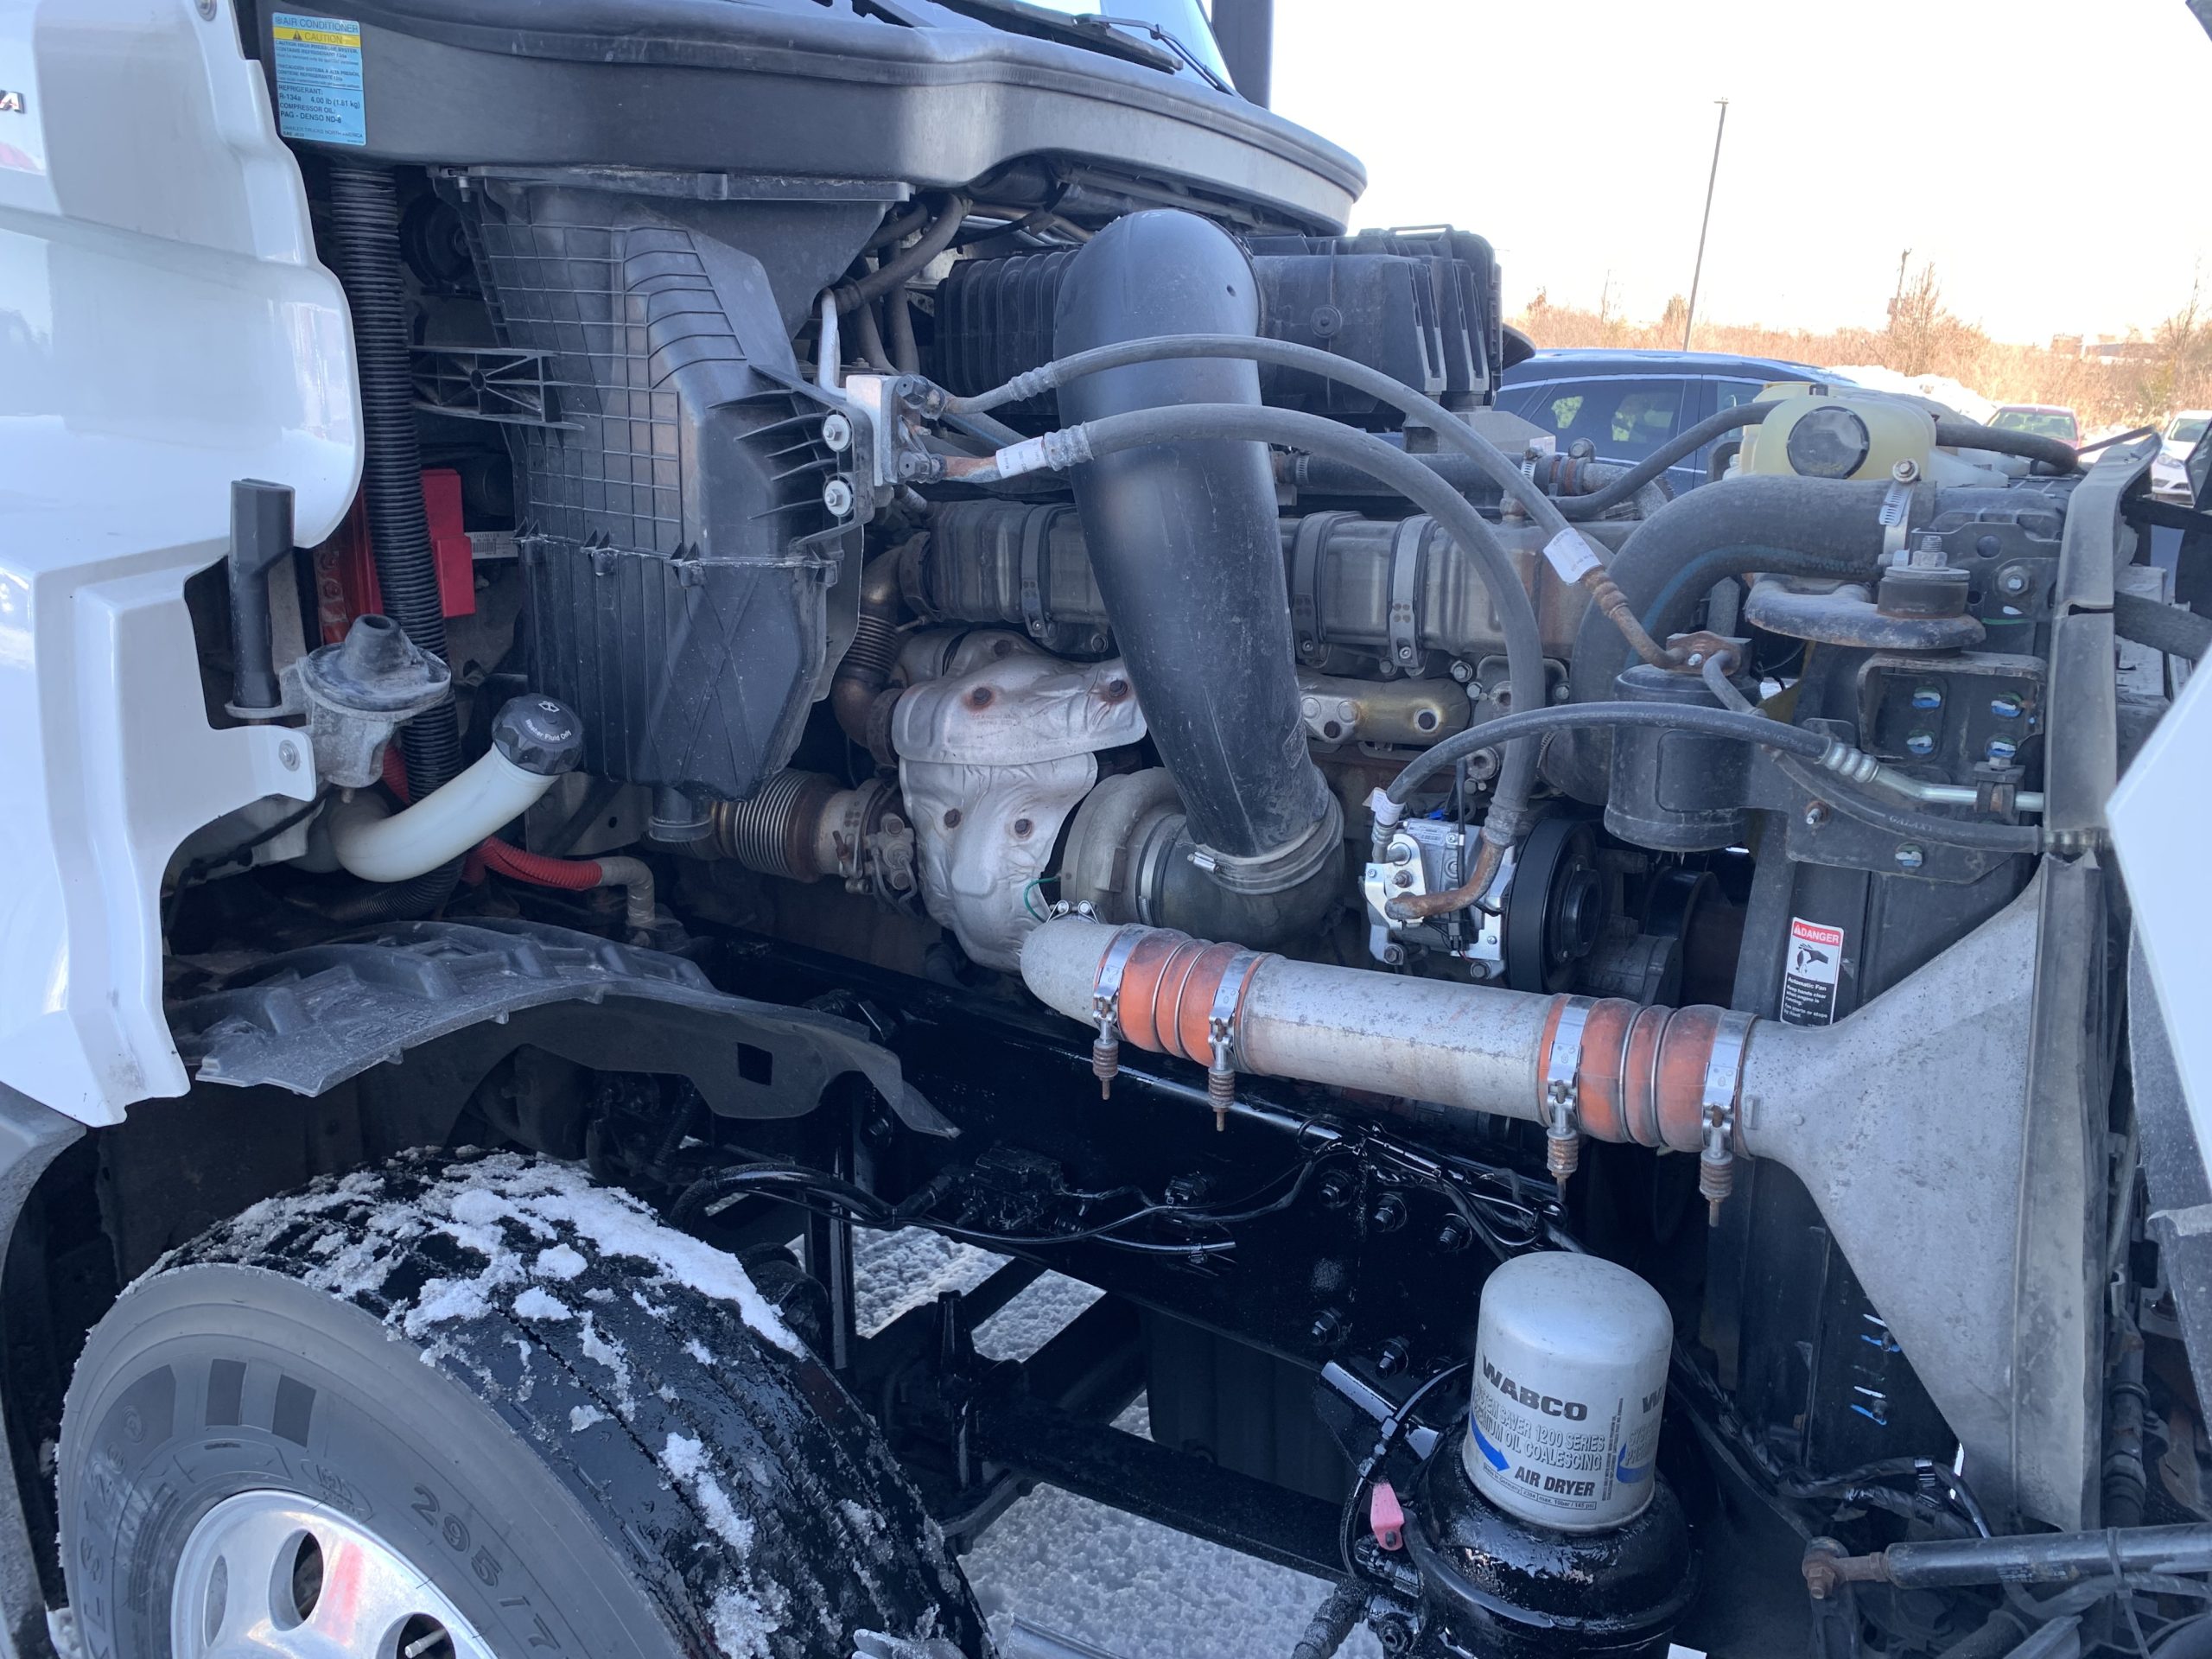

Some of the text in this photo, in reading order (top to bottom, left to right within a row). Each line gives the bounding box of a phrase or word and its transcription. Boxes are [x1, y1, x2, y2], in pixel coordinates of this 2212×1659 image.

[283, 16, 359, 33] AIR CONDITIONER
[304, 33, 343, 43] CAUTION
[280, 104, 322, 112] COMPRESSOR
[350, 100, 359, 109] kg)
[561, 729, 572, 740] Only
[1801, 928, 1839, 944] DANGER
[1788, 976, 1815, 988] Automatic
[1483, 1355, 1588, 1421] WABCO
[1501, 1403, 1531, 1438] SAVER
[1535, 1423, 1564, 1447] 1200
[1566, 1433, 1605, 1452] SERIES
[1505, 1429, 1521, 1453] OIL
[1524, 1441, 1602, 1471] COALESCING
[1500, 1475, 1521, 1493] Germany
[1514, 1465, 1595, 1497] AIR DRYER
